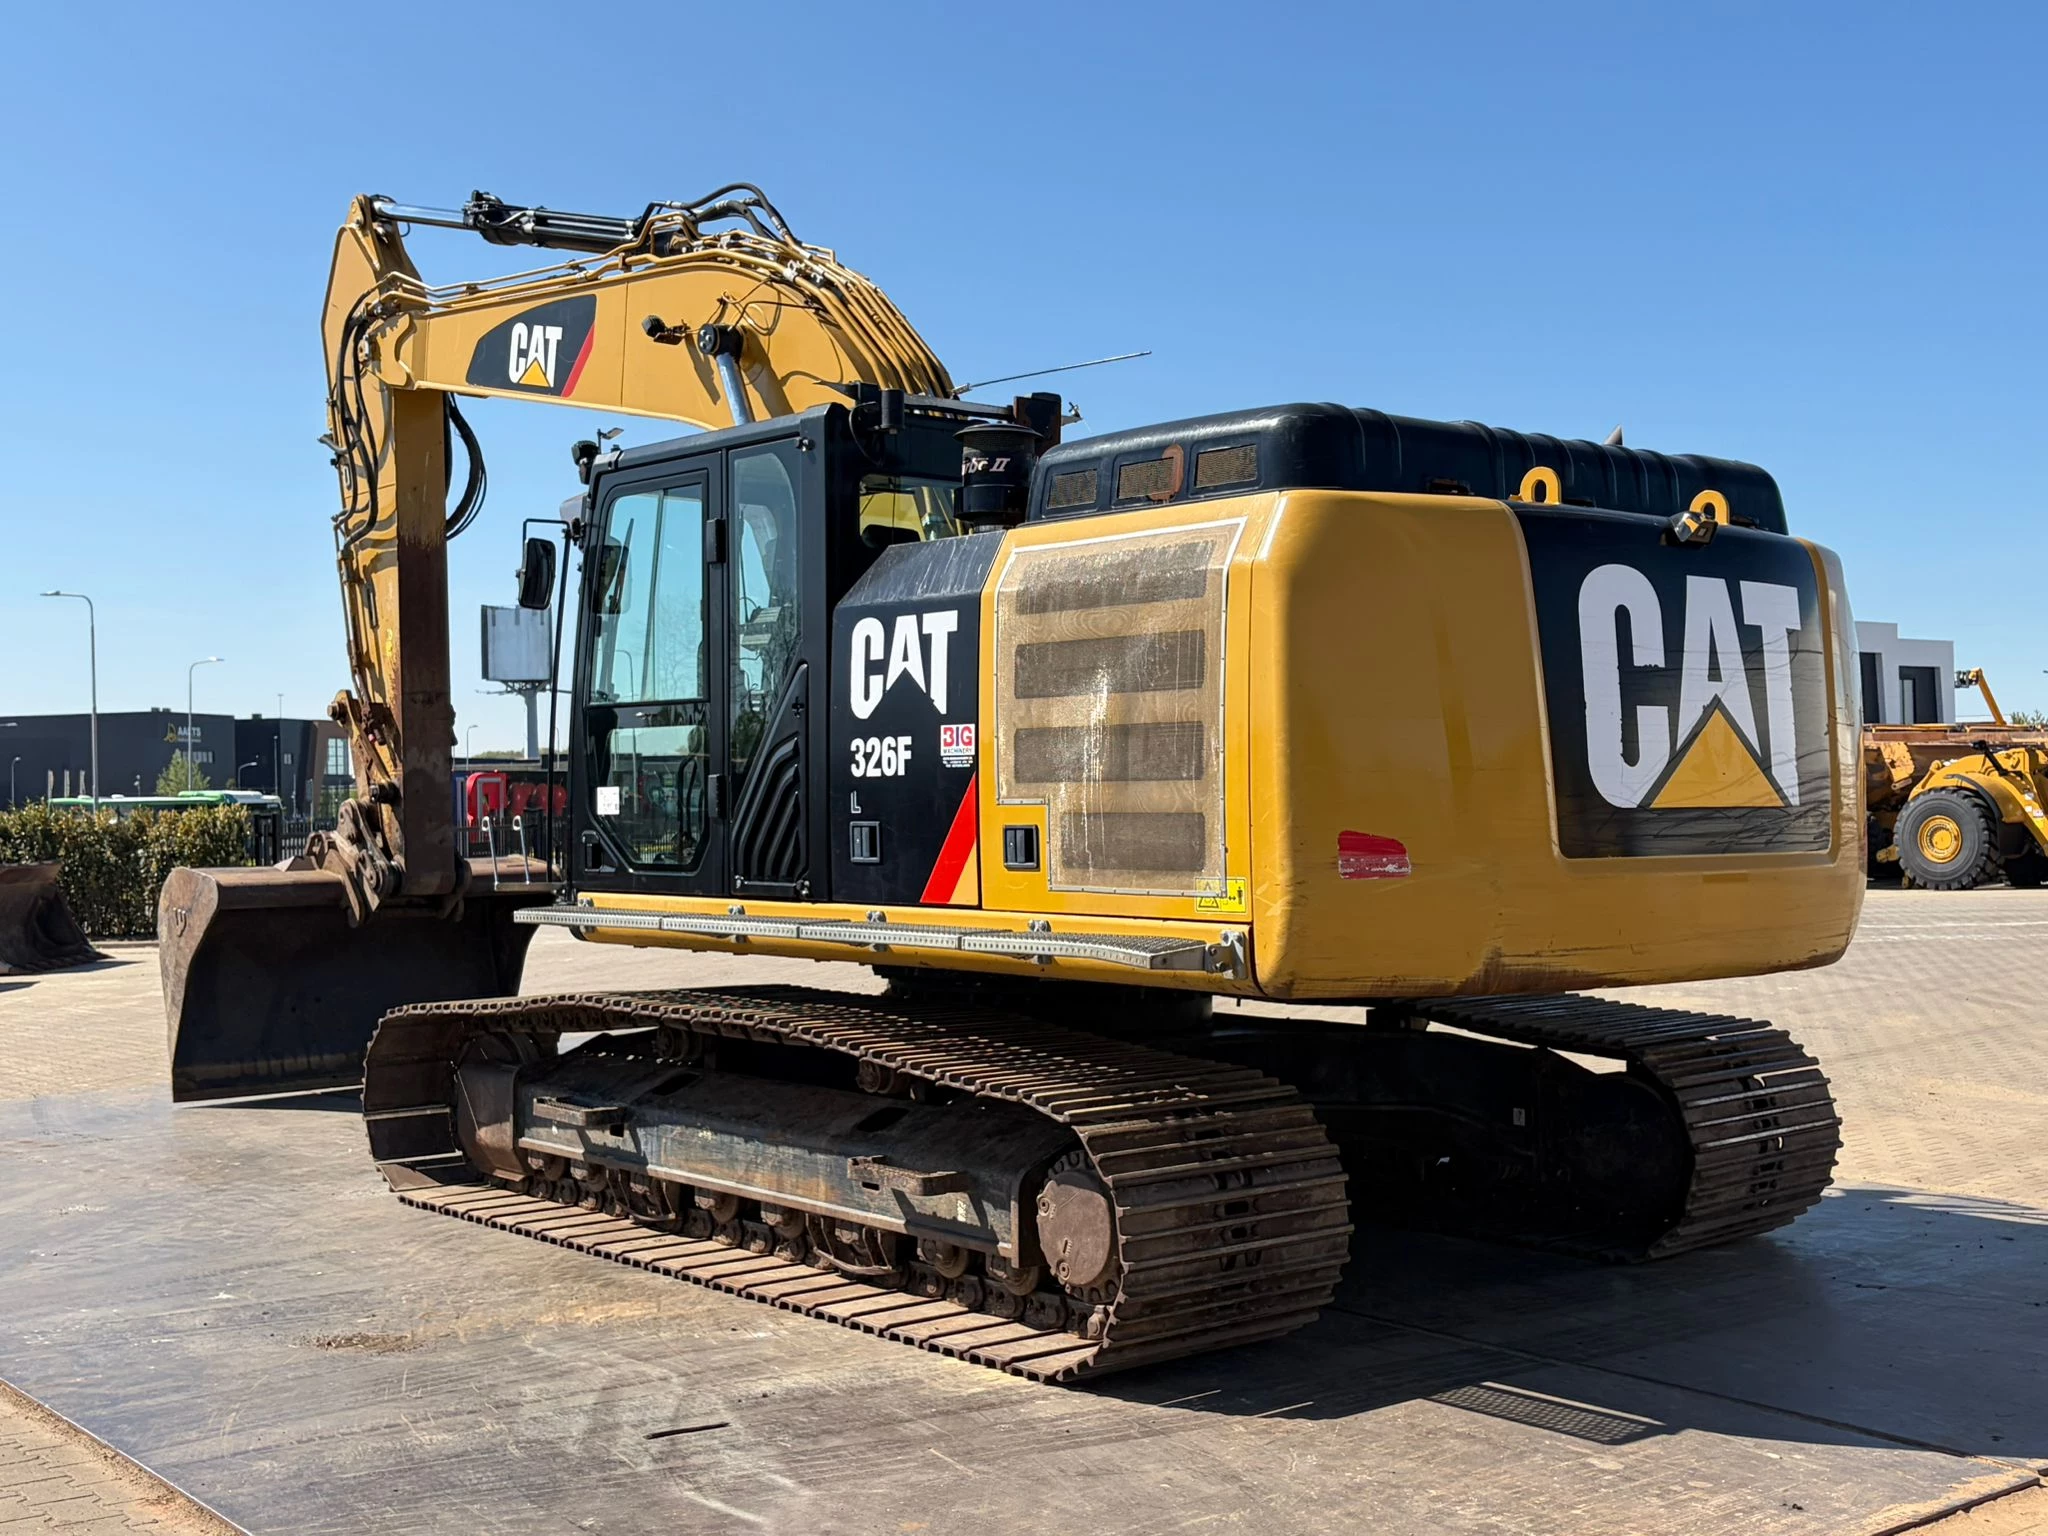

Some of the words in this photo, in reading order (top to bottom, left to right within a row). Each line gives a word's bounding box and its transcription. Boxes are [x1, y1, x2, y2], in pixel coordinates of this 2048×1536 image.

[509, 322, 563, 388] CAT
[851, 610, 958, 719] CAT
[1578, 563, 1801, 808] CAT
[851, 736, 912, 777] 326F
[943, 726, 973, 747] BIG
[850, 790, 862, 814] L
